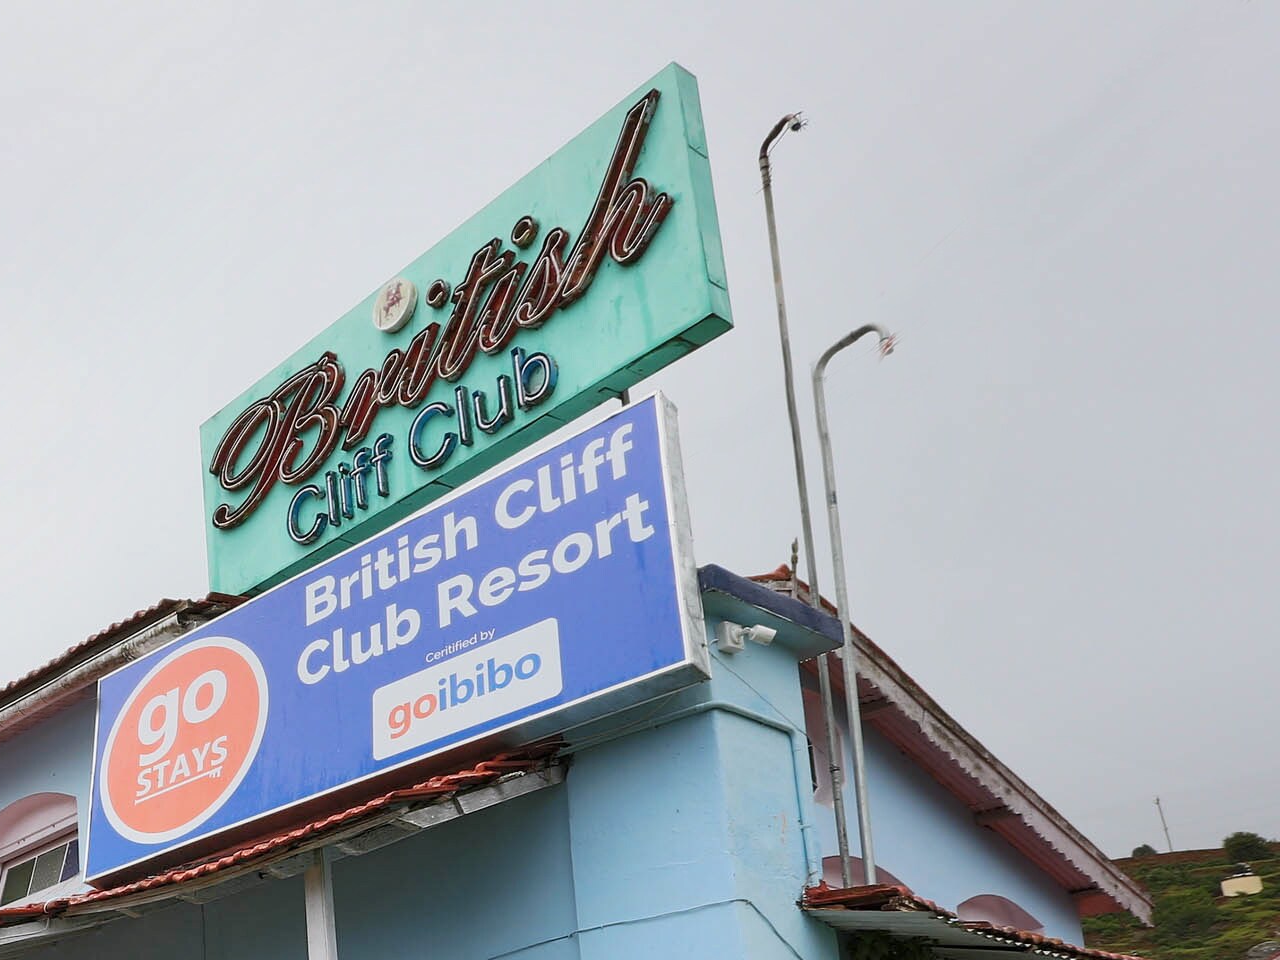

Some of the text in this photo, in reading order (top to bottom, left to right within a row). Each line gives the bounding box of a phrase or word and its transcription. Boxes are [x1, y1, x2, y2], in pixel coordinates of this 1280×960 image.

[210, 87, 676, 530] British
[287, 346, 559, 546] Cliff Club
[297, 492, 655, 685] Club Resort
[305, 422, 633, 626] British Cliff
[388, 652, 542, 740] goibibo
[480, 627, 496, 641] by
[135, 735, 228, 797] STAYS
[137, 669, 228, 767] go
